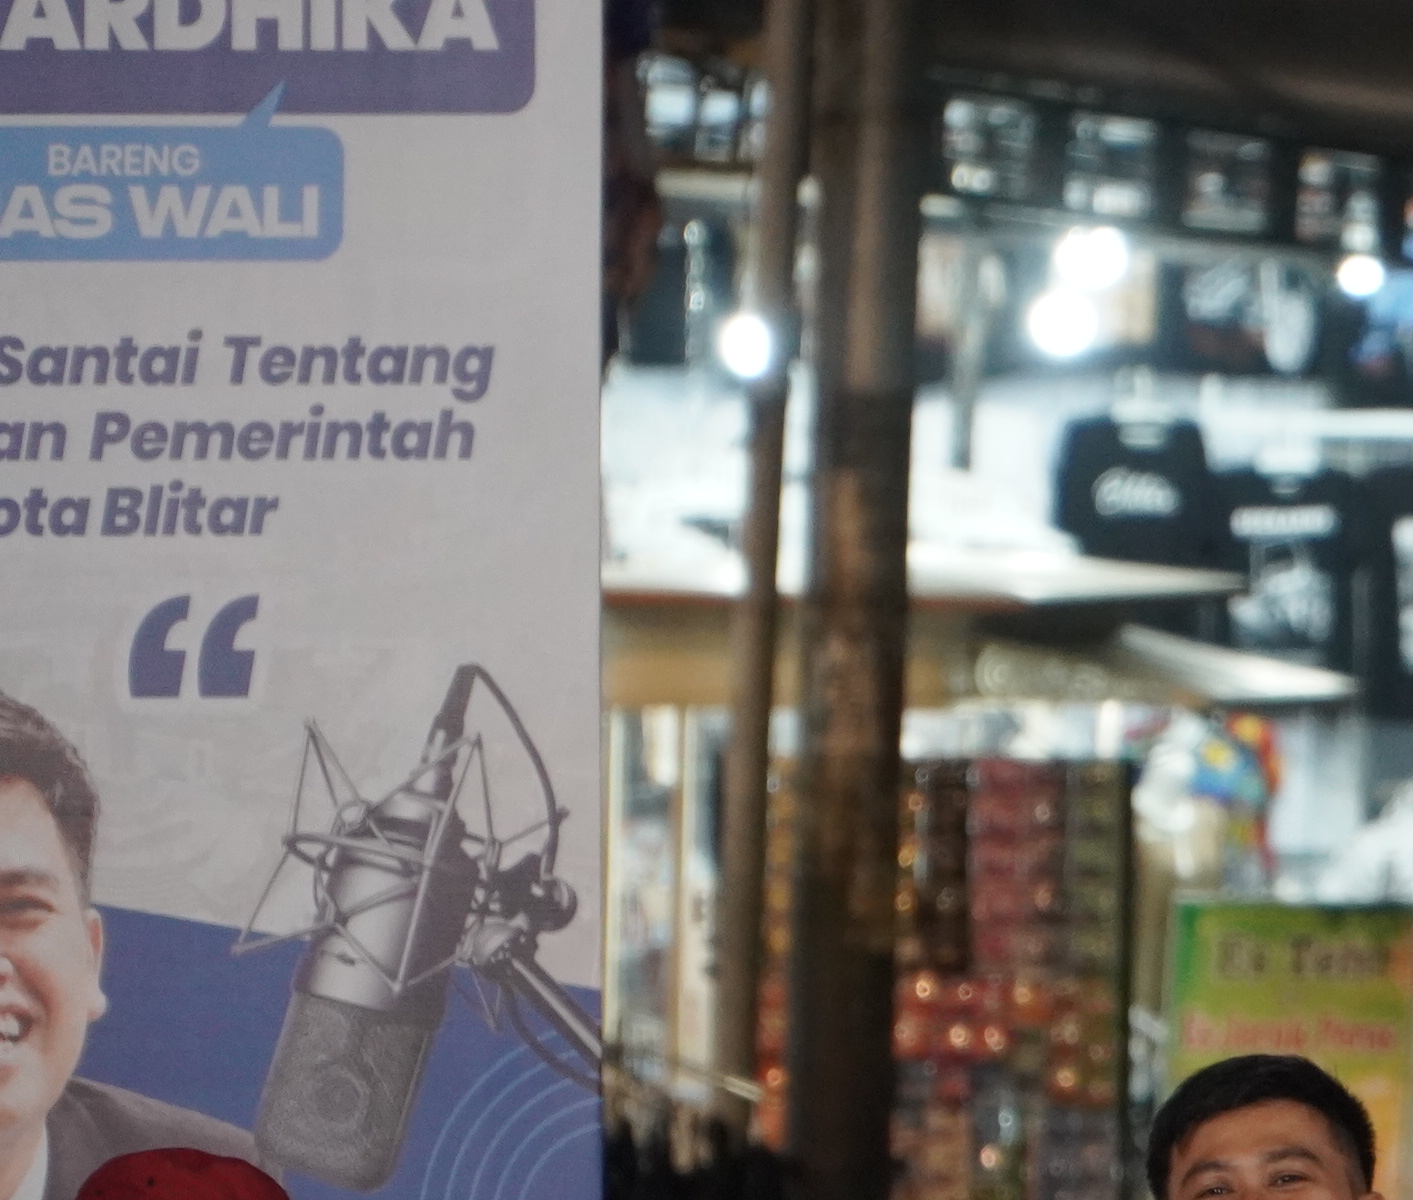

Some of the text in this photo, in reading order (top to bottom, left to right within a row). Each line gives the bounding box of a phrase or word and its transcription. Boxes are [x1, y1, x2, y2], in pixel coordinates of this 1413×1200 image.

[47, 143, 203, 178] BARENG
[129, 184, 320, 239] WALI
[0, 329, 495, 403] Santai Tentang
[88, 403, 475, 462] Pemerintah
[100, 479, 280, 538] Blitar
